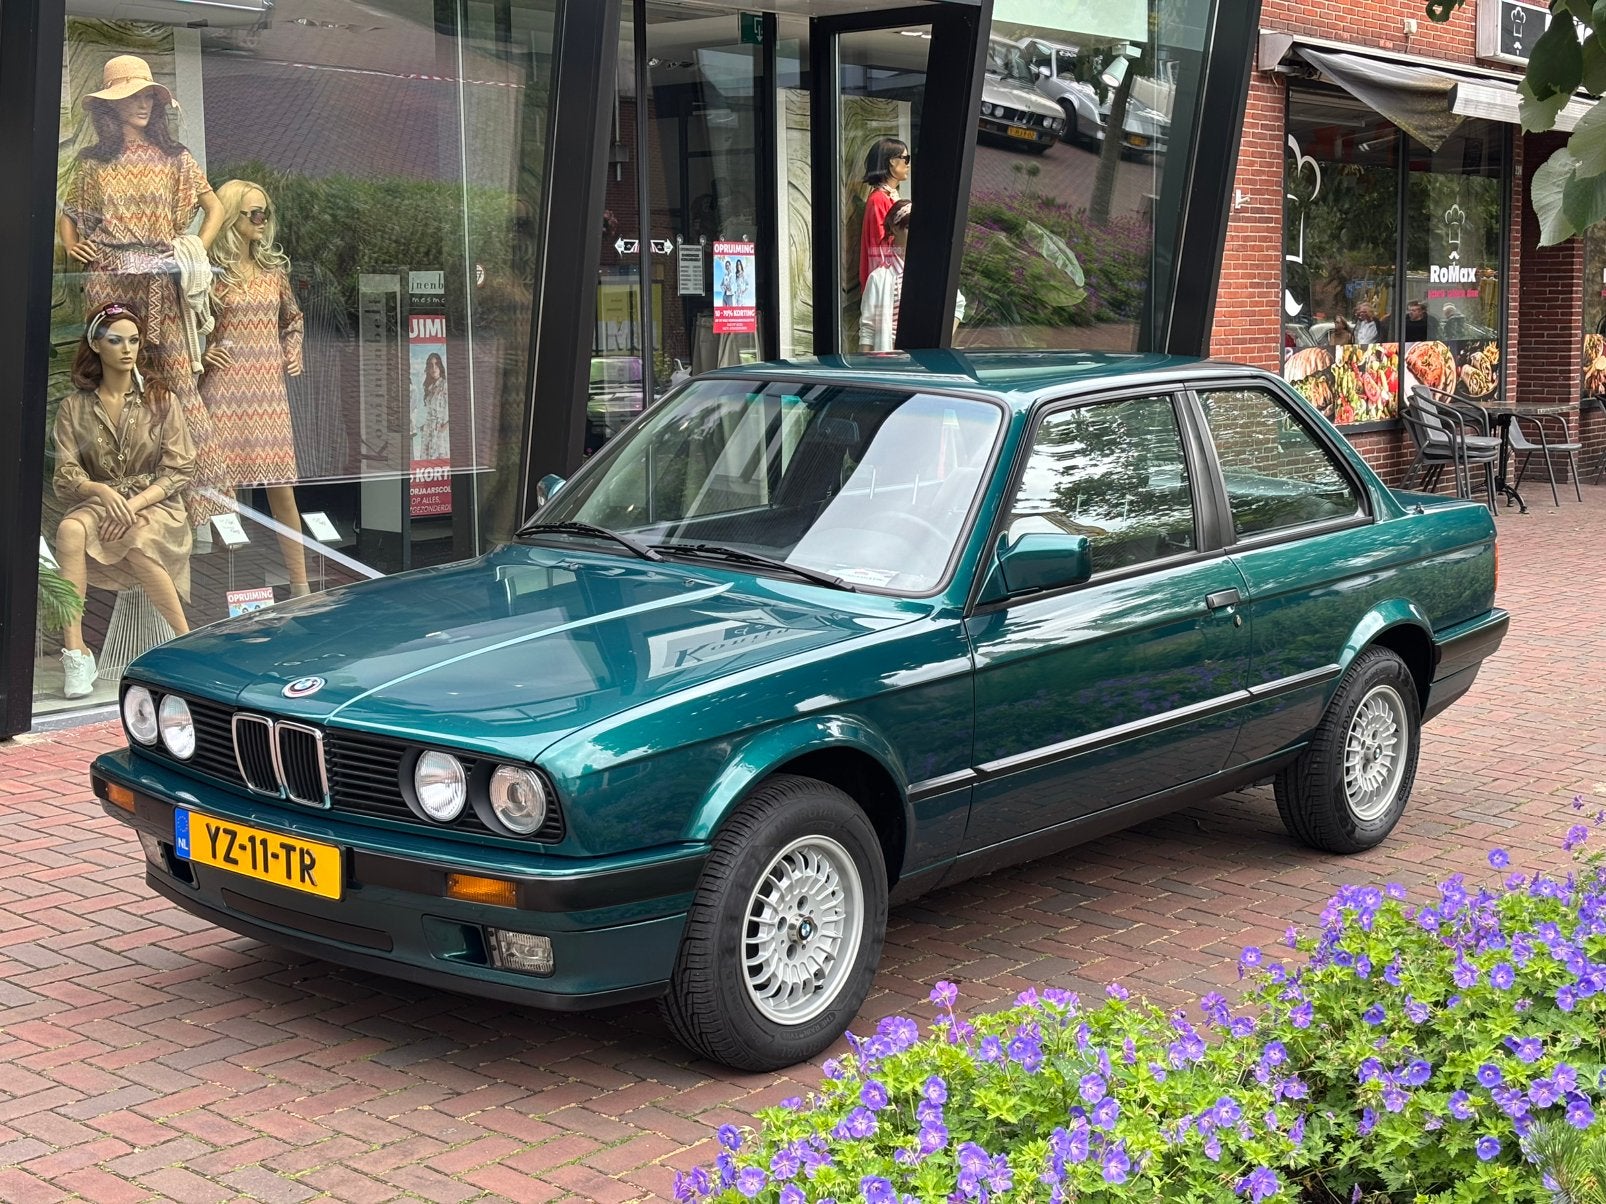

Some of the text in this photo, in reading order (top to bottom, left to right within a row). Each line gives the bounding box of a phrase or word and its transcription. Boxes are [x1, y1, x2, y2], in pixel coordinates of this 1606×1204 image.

[714, 243, 755, 254] OPRUIMING
[1430, 264, 1477, 283] RoMax
[228, 590, 273, 602] OPRUIMING
[177, 837, 189, 850] NL
[205, 822, 318, 887] YZ-11-TR
